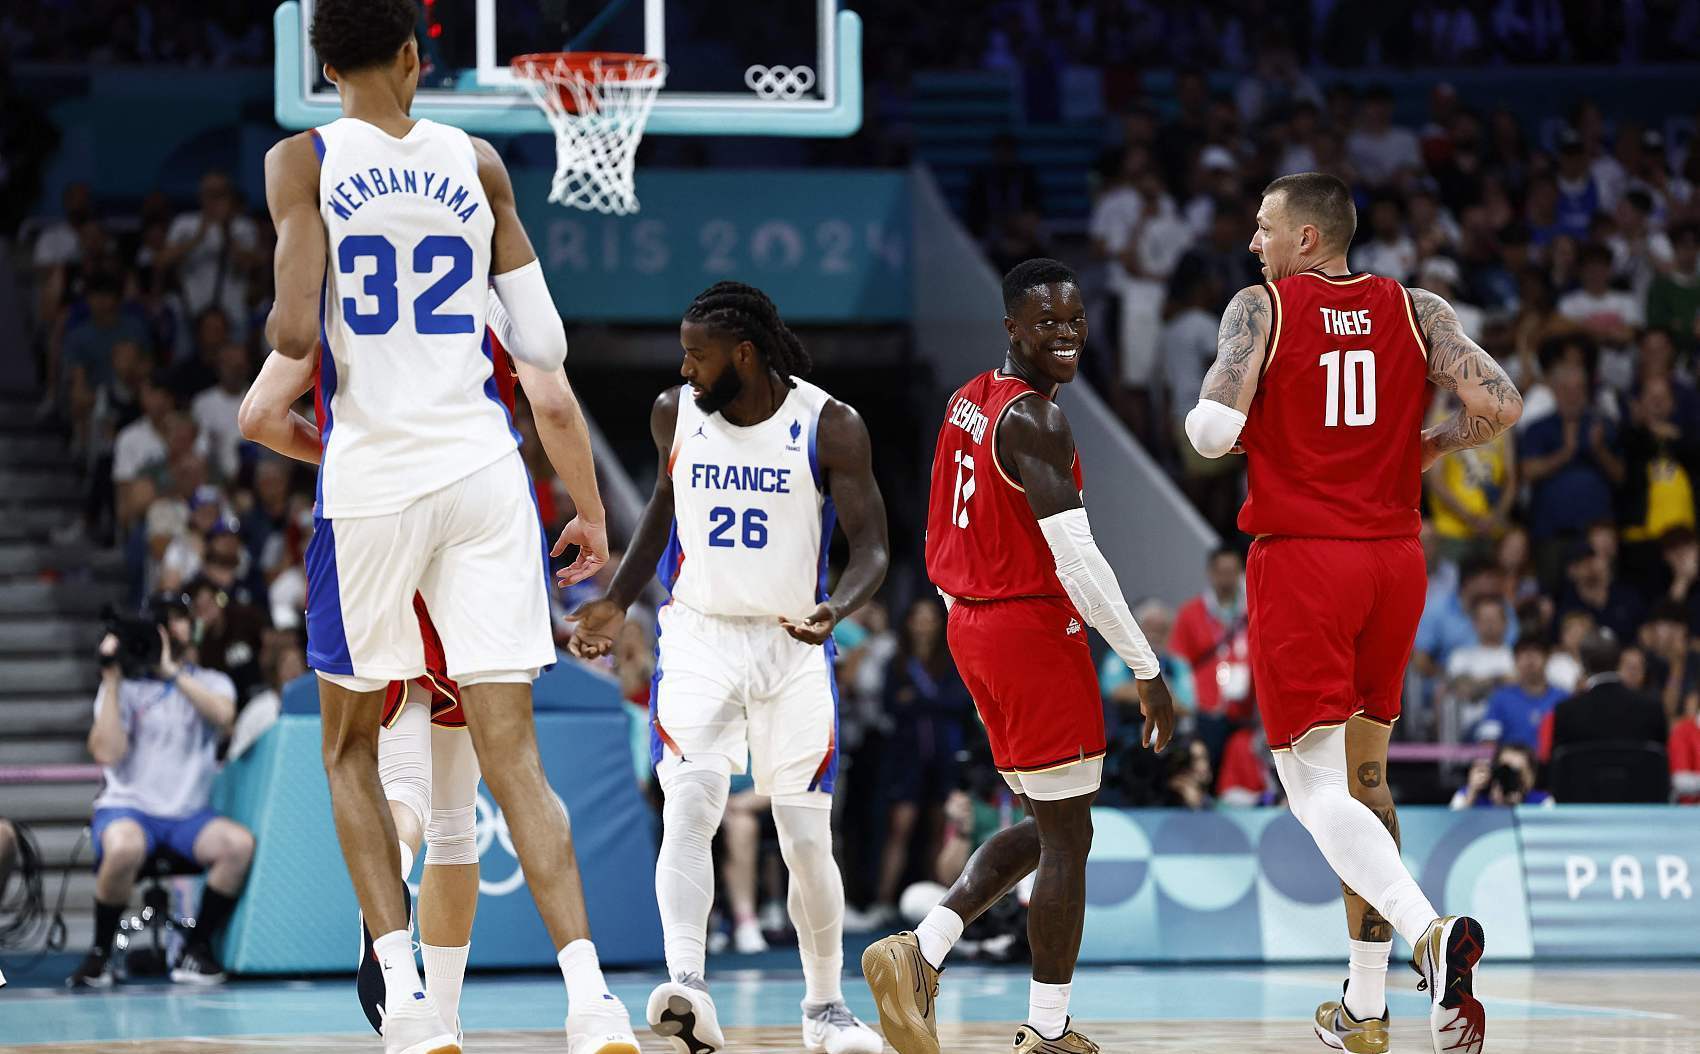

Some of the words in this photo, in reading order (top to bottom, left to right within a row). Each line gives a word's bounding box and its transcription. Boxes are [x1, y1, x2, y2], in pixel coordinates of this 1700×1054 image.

[328, 168, 479, 223] WEMBANYAMA
[338, 235, 475, 335] 32
[1319, 307, 1372, 335] THEIS
[1319, 350, 1376, 427] 10
[691, 463, 791, 493] FRANCE
[709, 506, 768, 549] 26
[1565, 854, 1693, 900] PAR
